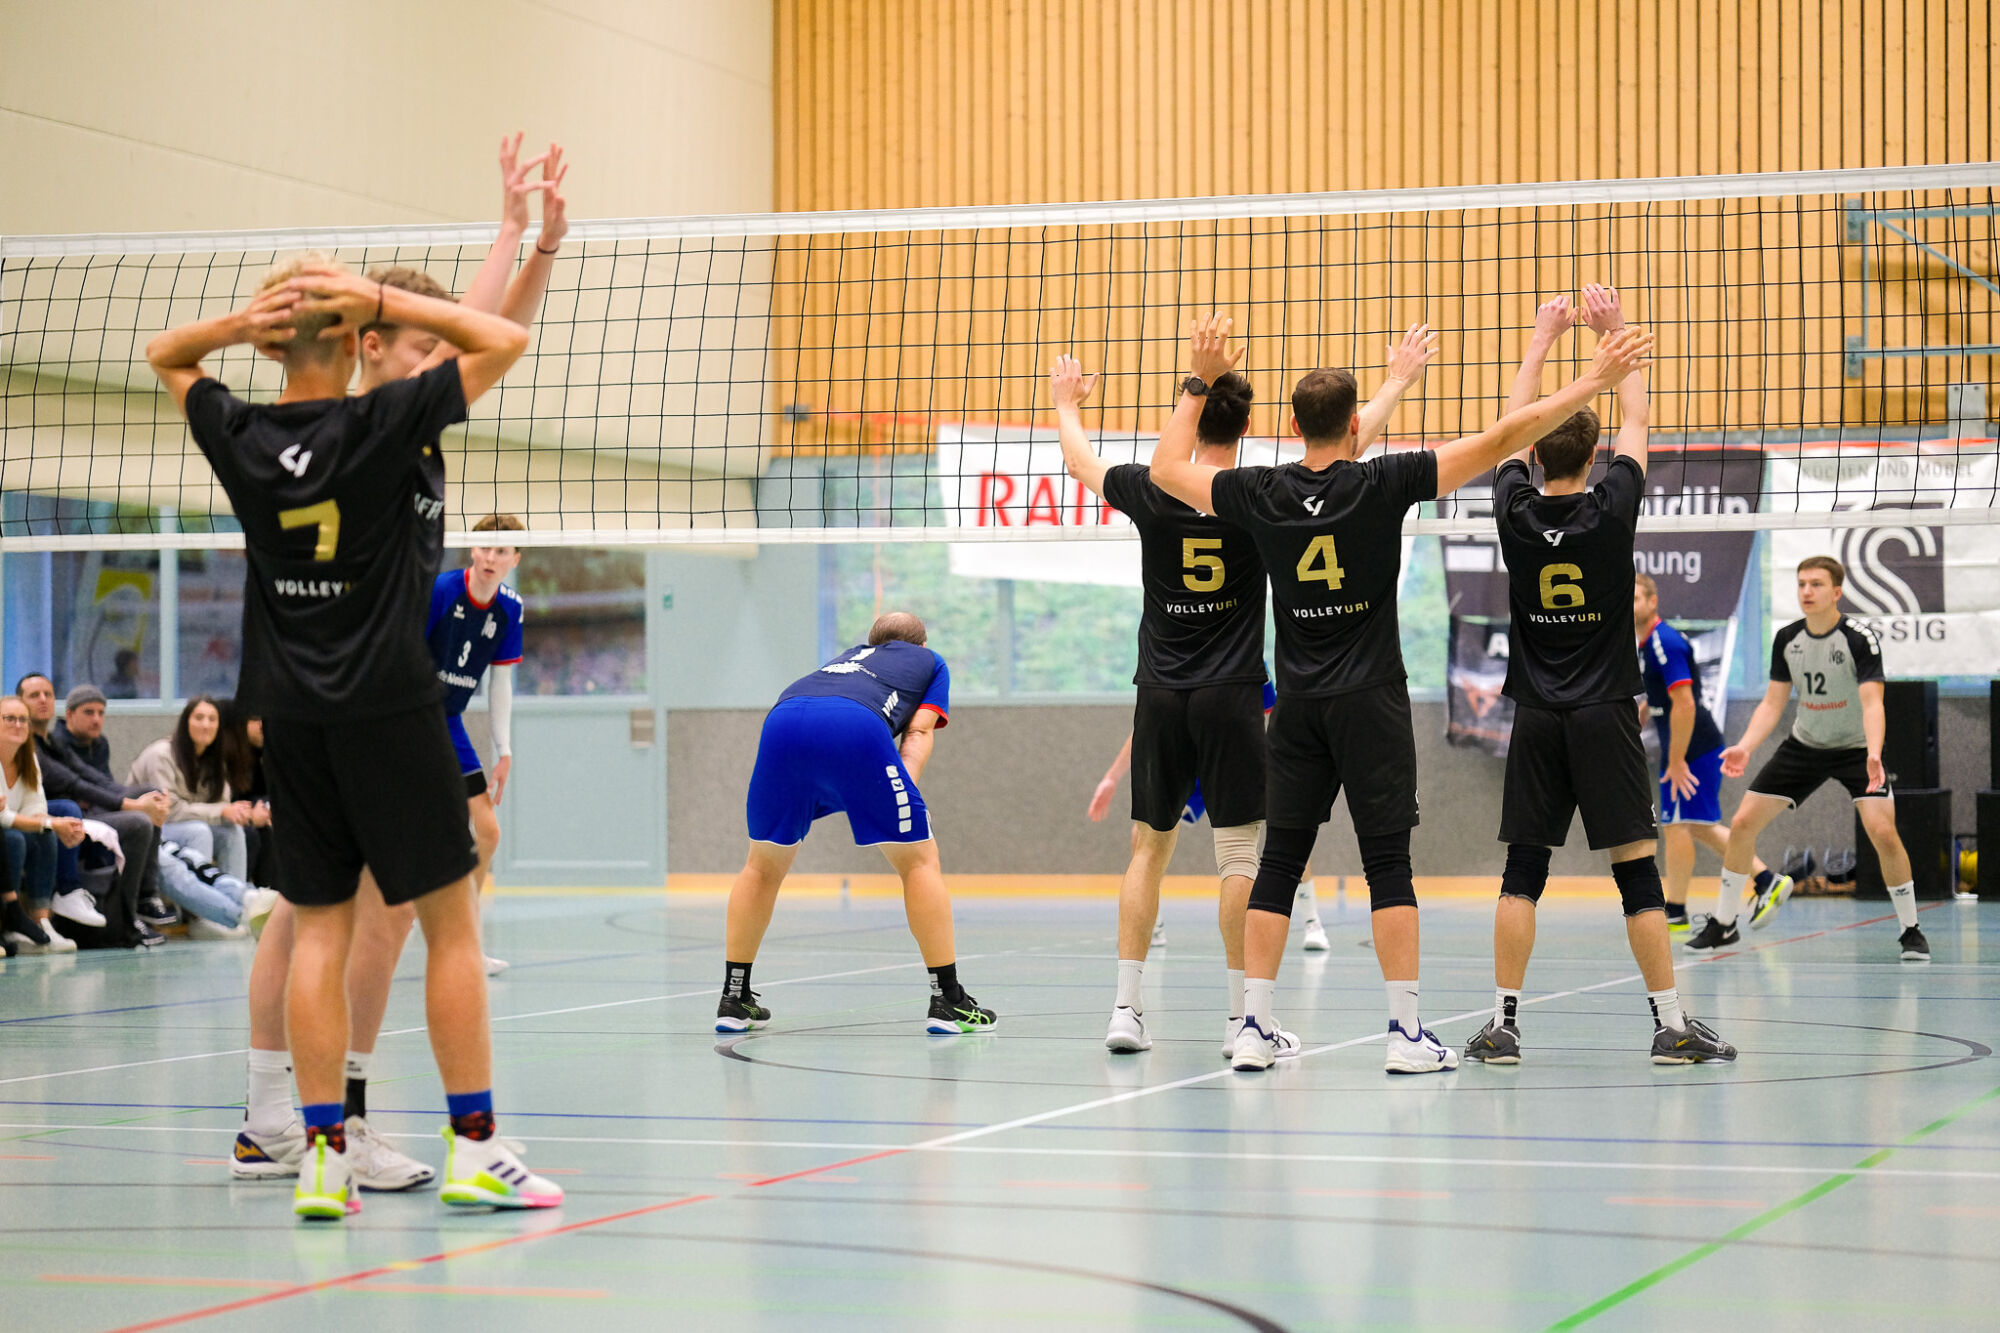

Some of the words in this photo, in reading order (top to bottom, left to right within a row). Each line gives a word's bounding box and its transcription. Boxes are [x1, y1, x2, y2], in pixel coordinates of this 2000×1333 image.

[278, 499, 341, 562] 7
[1182, 537, 1226, 592] 5
[1296, 534, 1345, 590] 4
[1539, 563, 1585, 610] 6
[1166, 598, 1237, 614] VOLLEYURI
[1293, 601, 1369, 618] VOLLEYURI
[1529, 612, 1601, 623] VOLLEYURI
[458, 640, 472, 668] 3
[1803, 671, 1828, 695] 12
